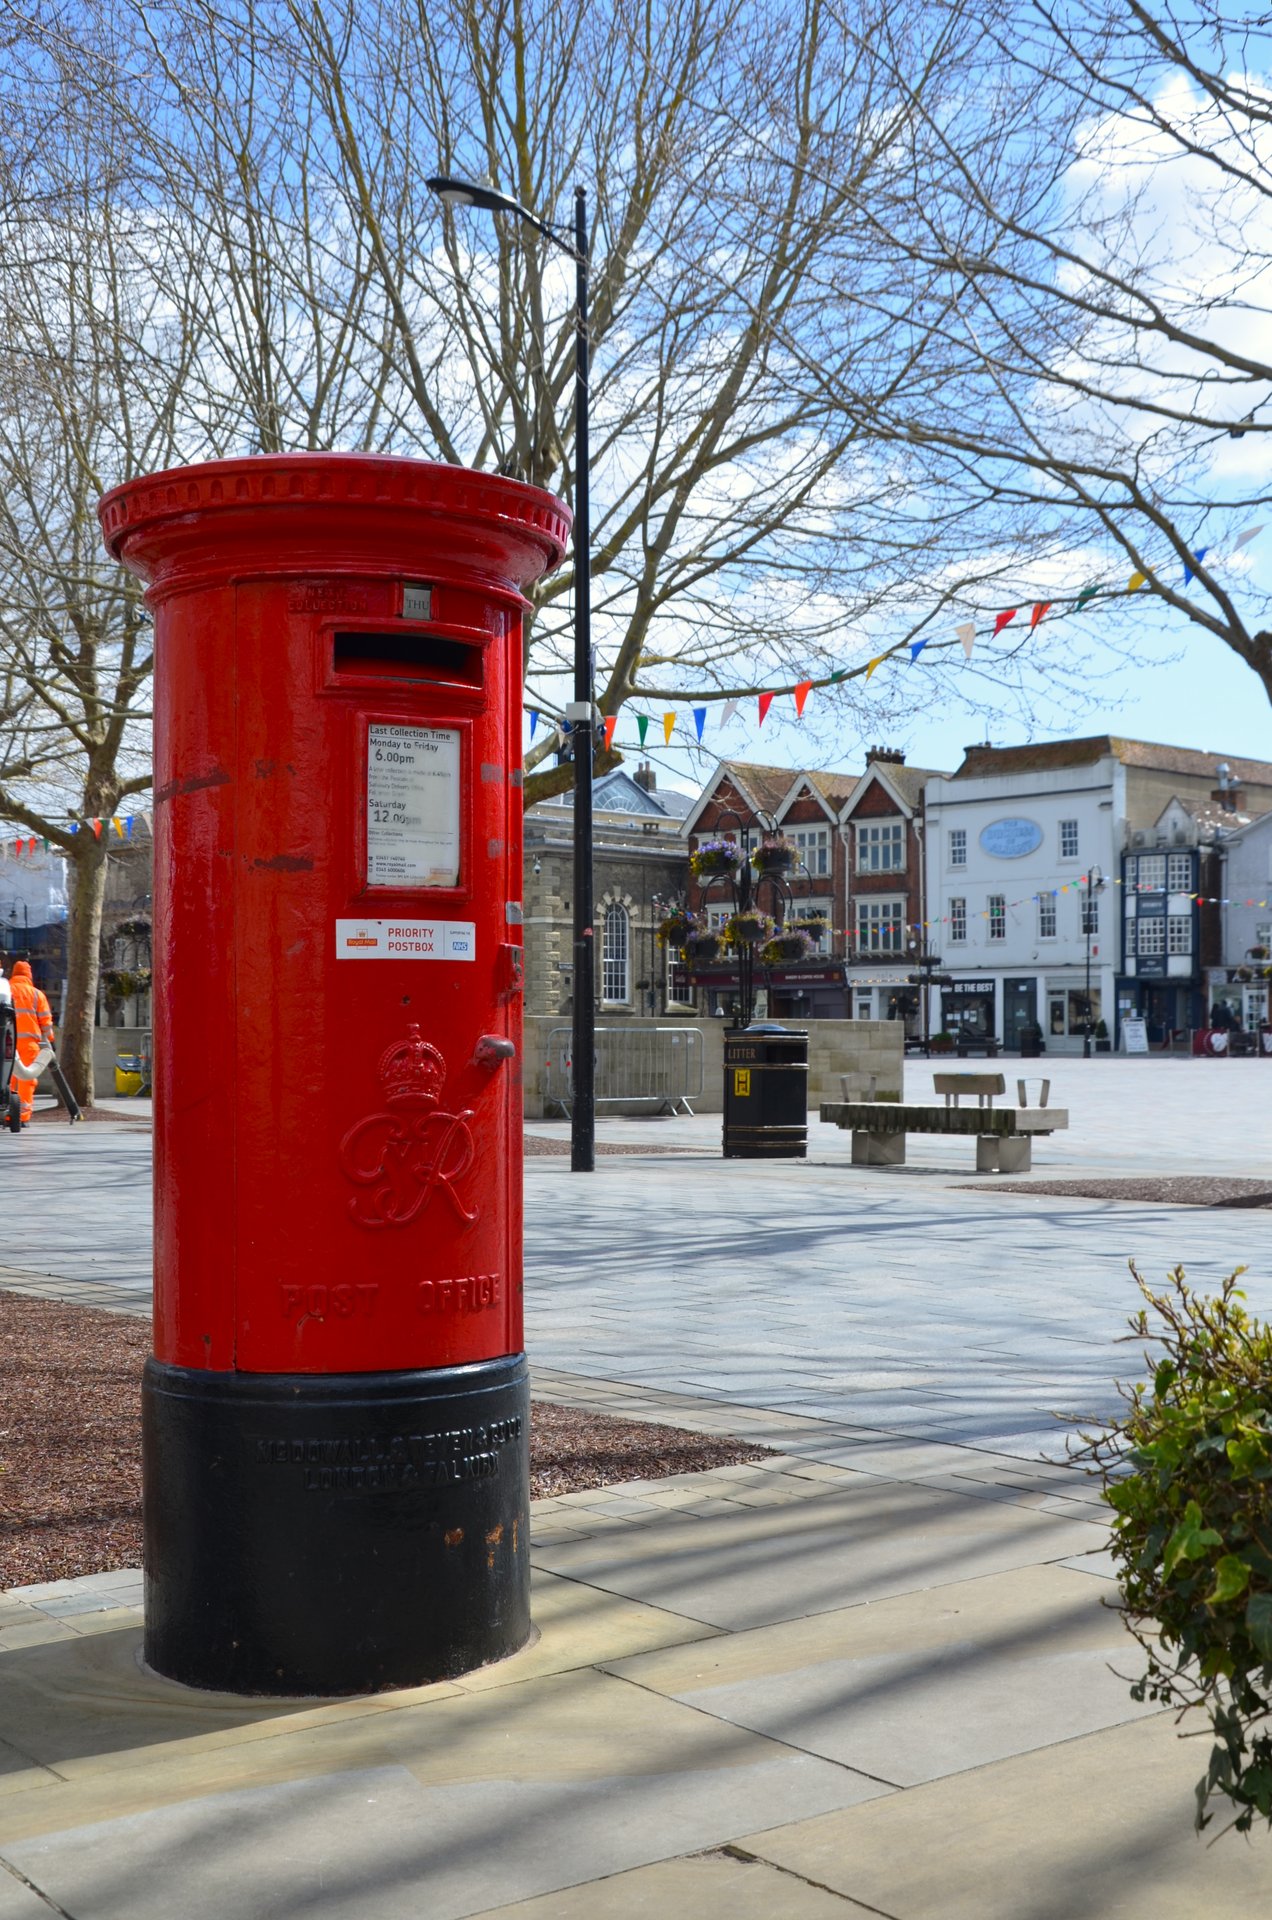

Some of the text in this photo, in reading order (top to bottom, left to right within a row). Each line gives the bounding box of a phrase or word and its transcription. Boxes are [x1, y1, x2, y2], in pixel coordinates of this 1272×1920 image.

[287, 599, 368, 612] COLLECTION
[406, 599, 430, 611] THU
[370, 726, 451, 741] Last Collection Time
[370, 738, 439, 753] Monday to Friday
[375, 749, 415, 764] 6.00pm
[369, 799, 407, 811] Saturday
[388, 928, 434, 938] PRIORITY
[349, 939, 363, 947] Royal
[388, 942, 434, 952] POSTBOX
[453, 941, 468, 951] NHS
[954, 983, 964, 992] BE
[964, 983, 976, 992] THE
[977, 982, 994, 992] BEST
[728, 1047, 756, 1059] LITTER
[417, 1272, 501, 1315] OFFICE
[280, 1282, 379, 1319] POST
